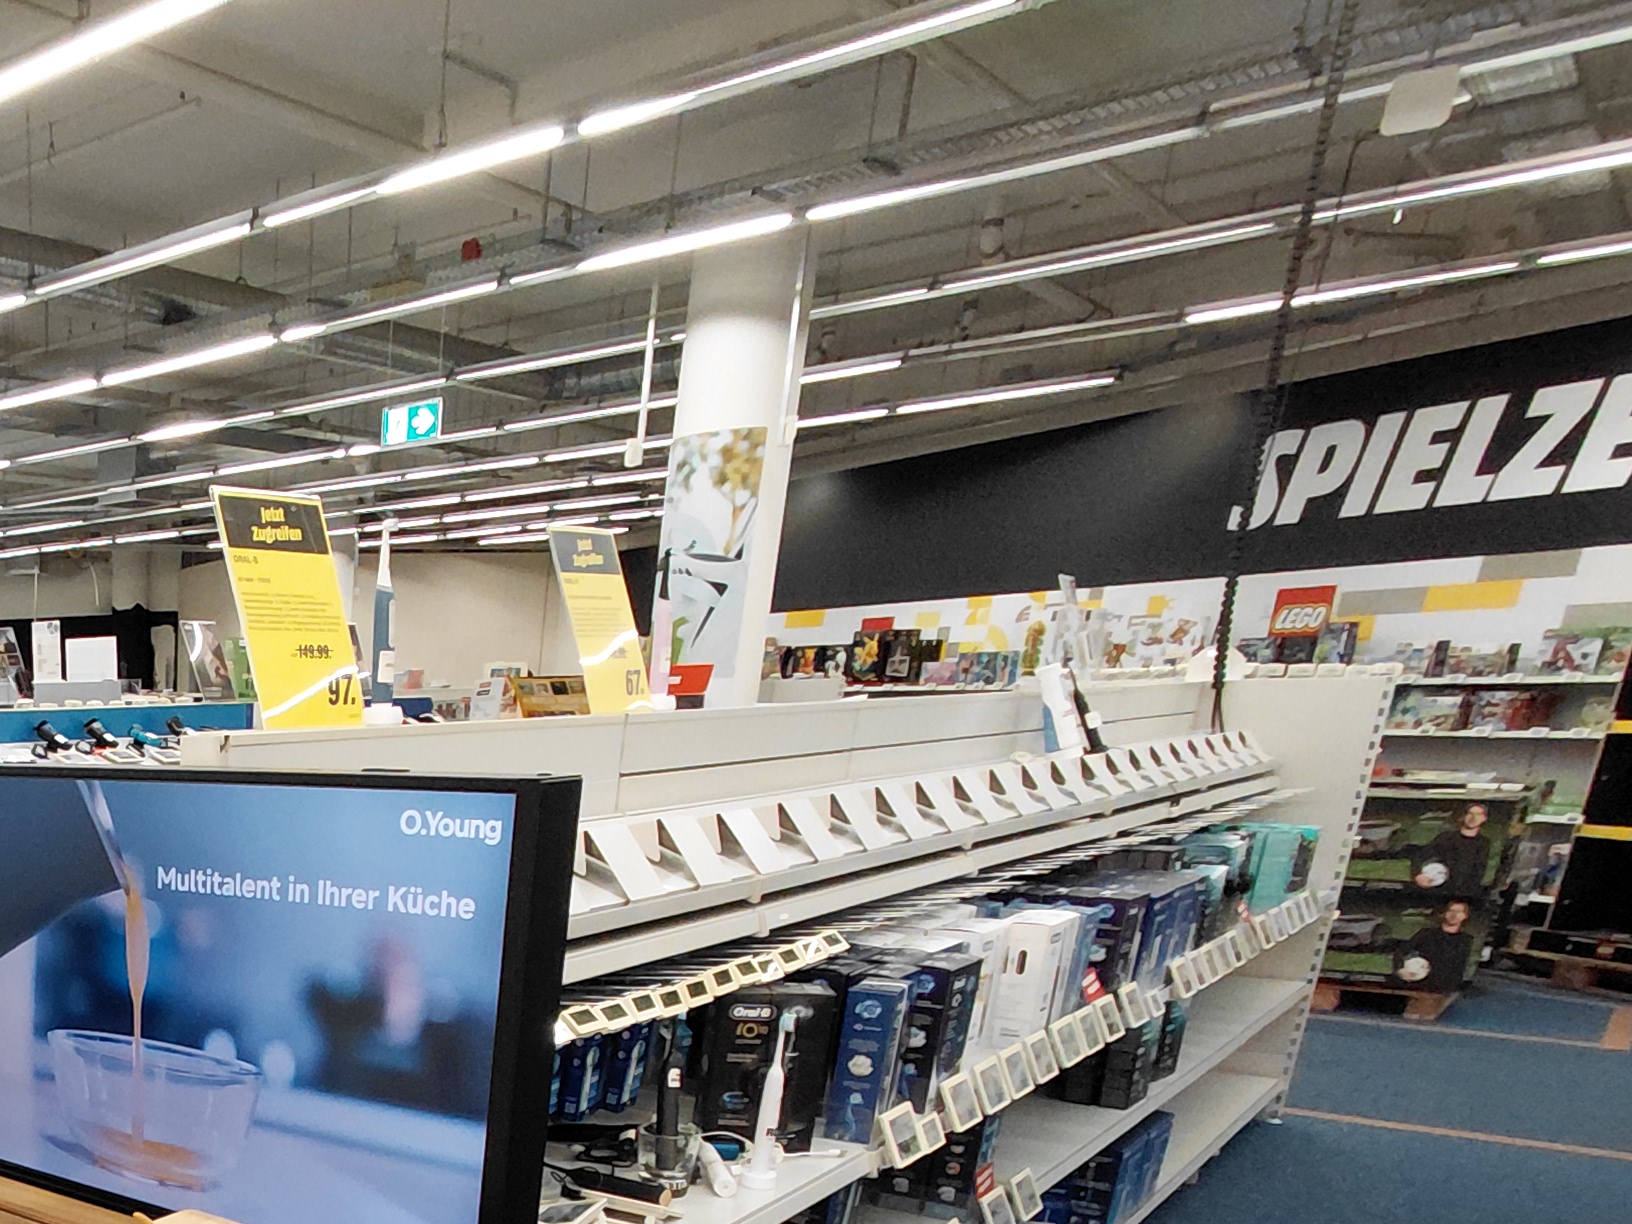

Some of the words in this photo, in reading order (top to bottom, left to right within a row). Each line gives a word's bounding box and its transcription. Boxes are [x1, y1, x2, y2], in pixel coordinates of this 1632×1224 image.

[250, 525, 303, 544] Zugreifen
[1274, 606, 1327, 630] LEGO
[399, 809, 503, 846] O.Young
[156, 866, 281, 902] Multitalent
[287, 875, 310, 904] in
[317, 879, 381, 911] Ihrer
[387, 885, 477, 920] Küche
